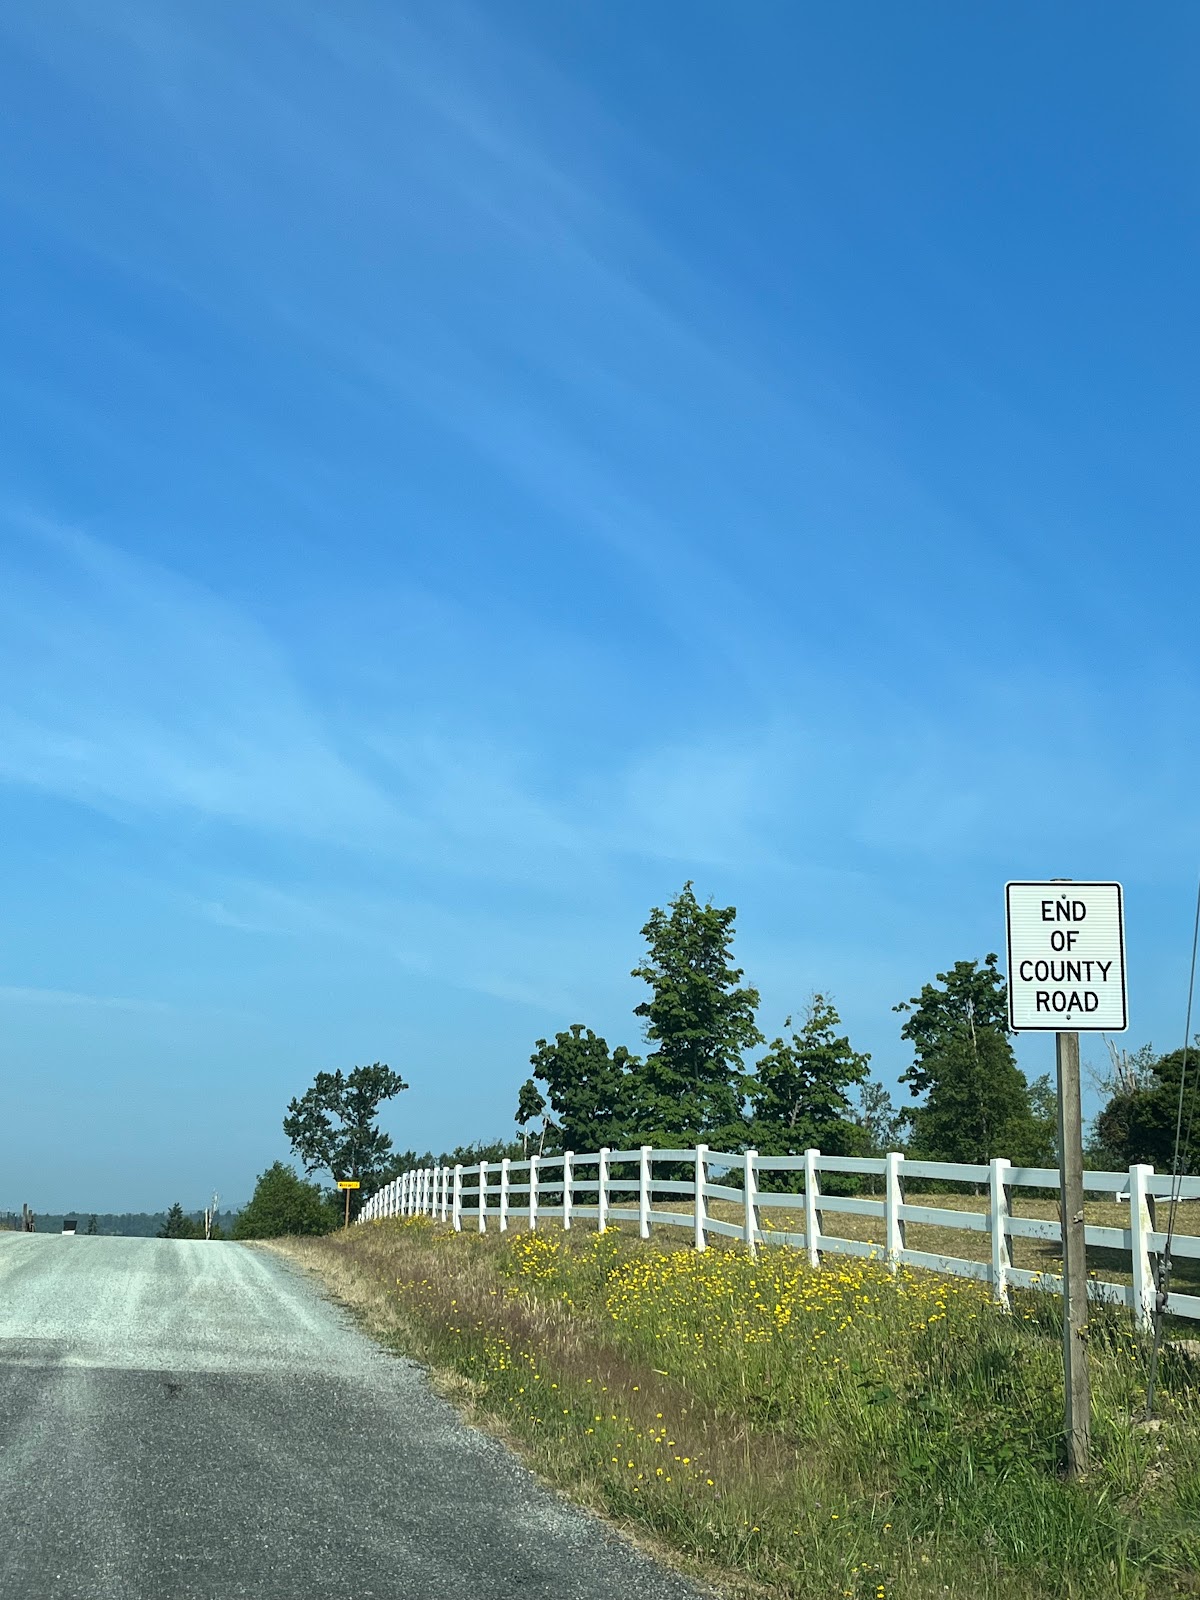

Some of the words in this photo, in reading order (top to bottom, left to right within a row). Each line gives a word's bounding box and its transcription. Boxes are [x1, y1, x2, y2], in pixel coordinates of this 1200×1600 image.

[1041, 900, 1087, 922] END
[1051, 930, 1080, 952] OF
[1020, 960, 1112, 982] COUNTY
[1036, 990, 1099, 1012] ROAD
